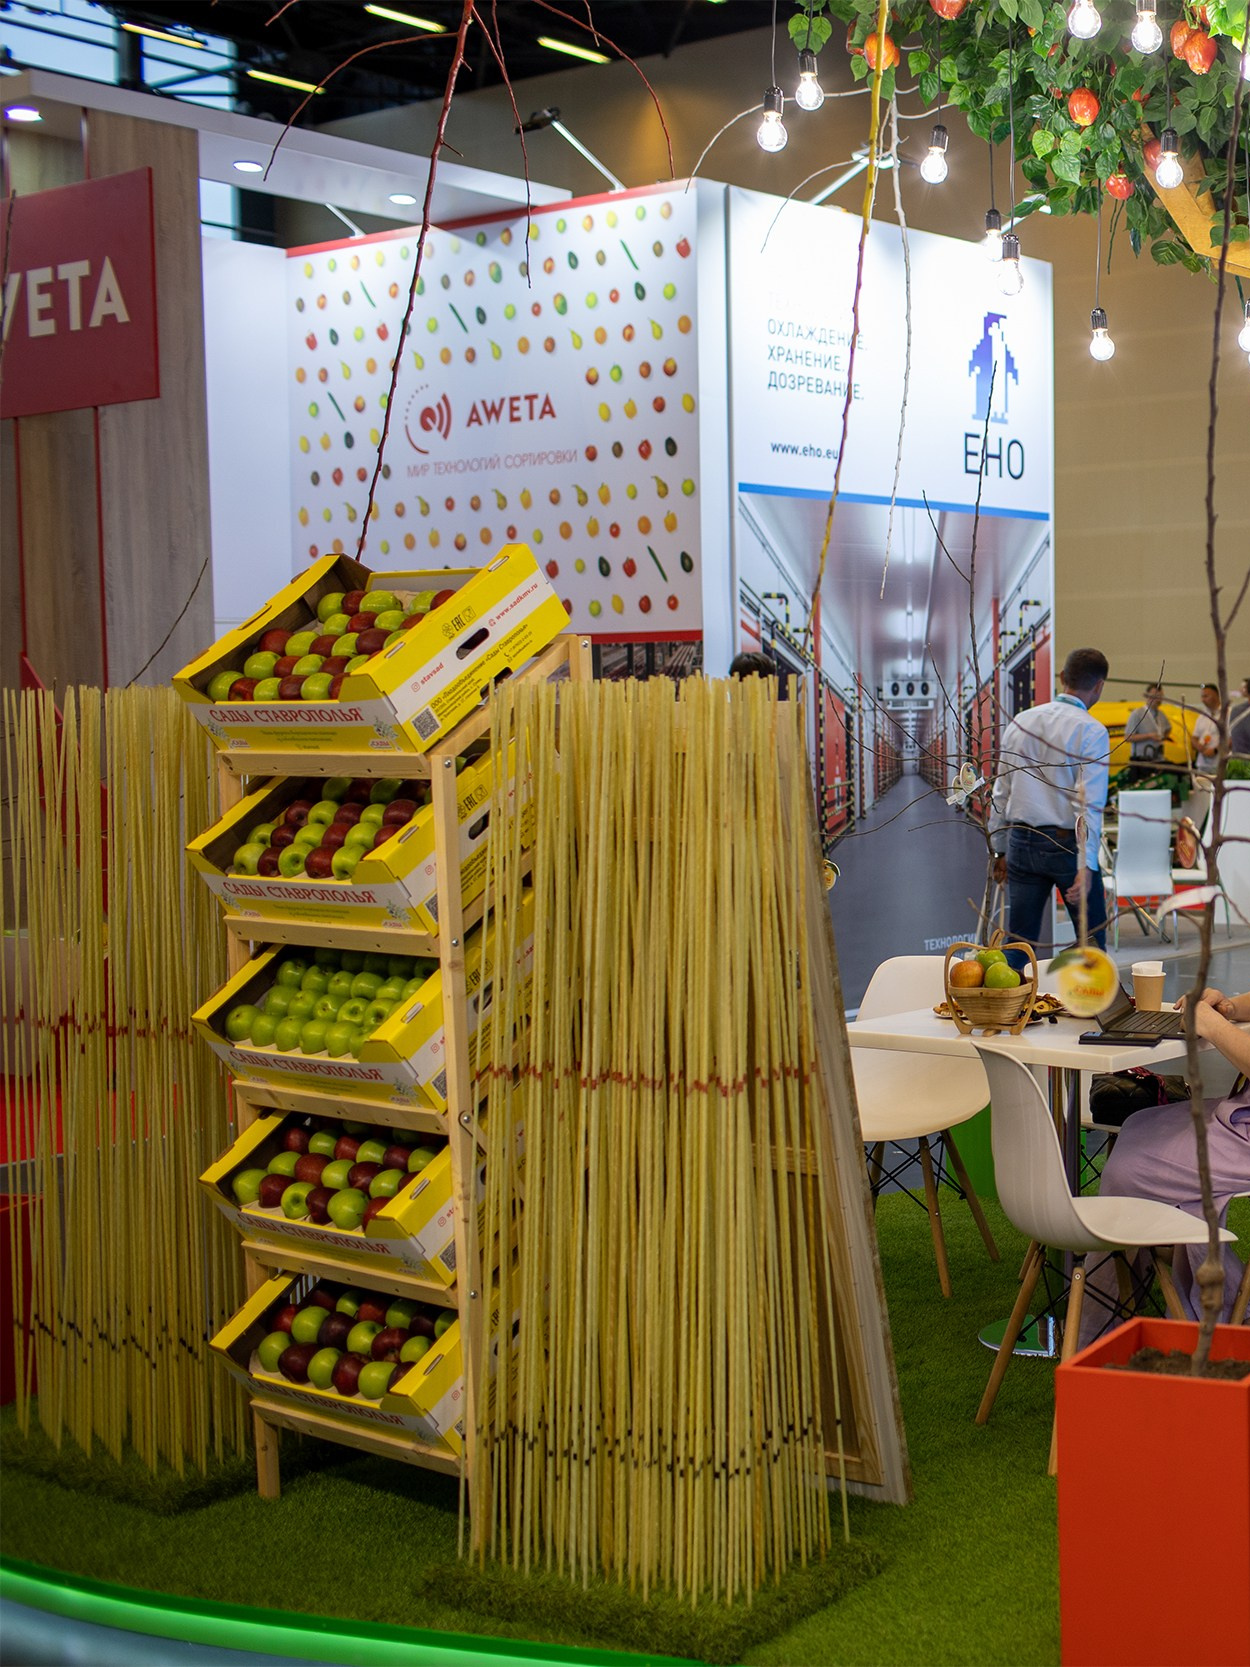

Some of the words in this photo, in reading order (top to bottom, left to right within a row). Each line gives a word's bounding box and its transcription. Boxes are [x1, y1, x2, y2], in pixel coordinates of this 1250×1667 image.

[768, 345, 845, 372] ХРАНЕНИЕ.
[466, 393, 556, 427] AWETA
[407, 464, 430, 477] МИР
[434, 454, 500, 475] ТЕХНОЛОГИЙ
[504, 449, 578, 469] СОРТИРОВКИ
[771, 442, 838, 460] www.eho.eu
[420, 662, 444, 685] stavsad
[209, 709, 254, 723] САДЫ
[254, 708, 364, 723] СТАВРОПОЛЬЯ
[223, 882, 267, 897] САДЫ
[266, 885, 378, 903] СТАВРОПОЛЬЯ
[229, 1050, 273, 1067] САДЫ
[273, 1057, 384, 1081] СТАВРОПОЛЬЯ
